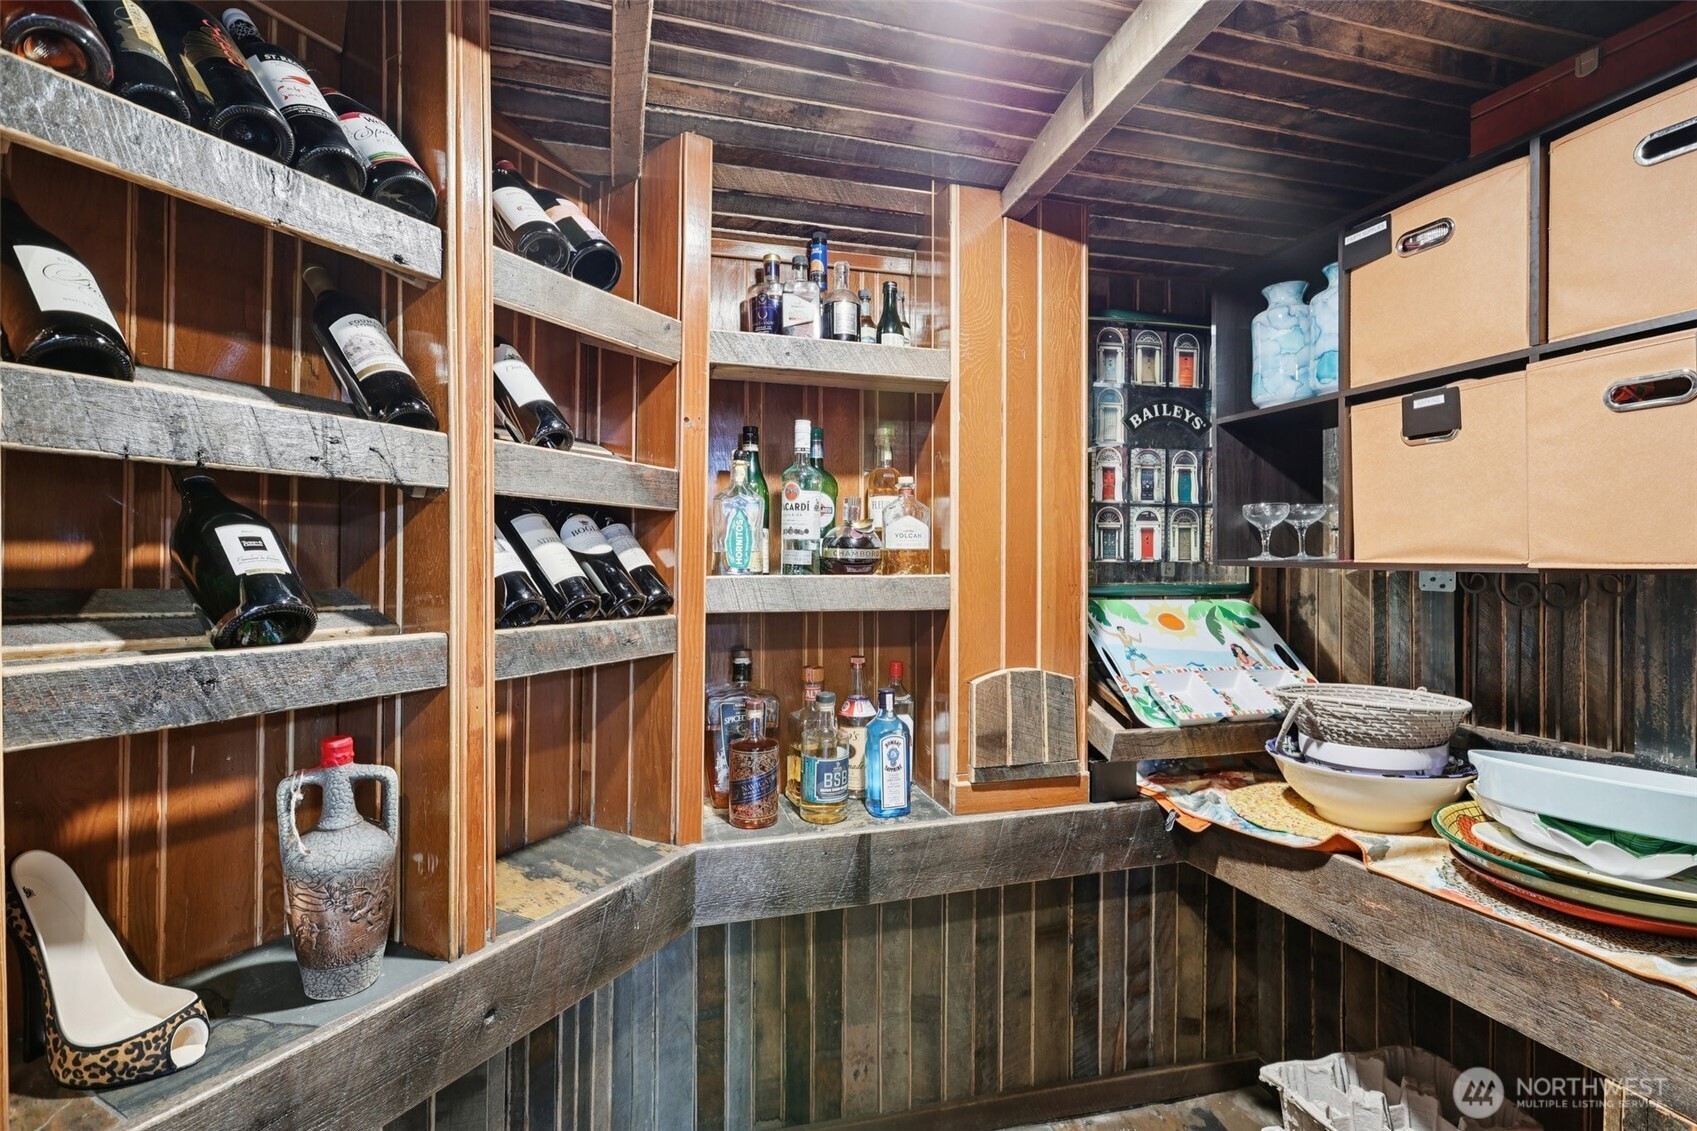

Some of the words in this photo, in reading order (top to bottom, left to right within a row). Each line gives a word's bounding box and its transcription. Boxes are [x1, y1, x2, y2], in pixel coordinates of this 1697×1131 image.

[1129, 403, 1204, 430] BAILEYS
[735, 519, 744, 565] HORNITOS
[824, 769, 847, 788] BSB
